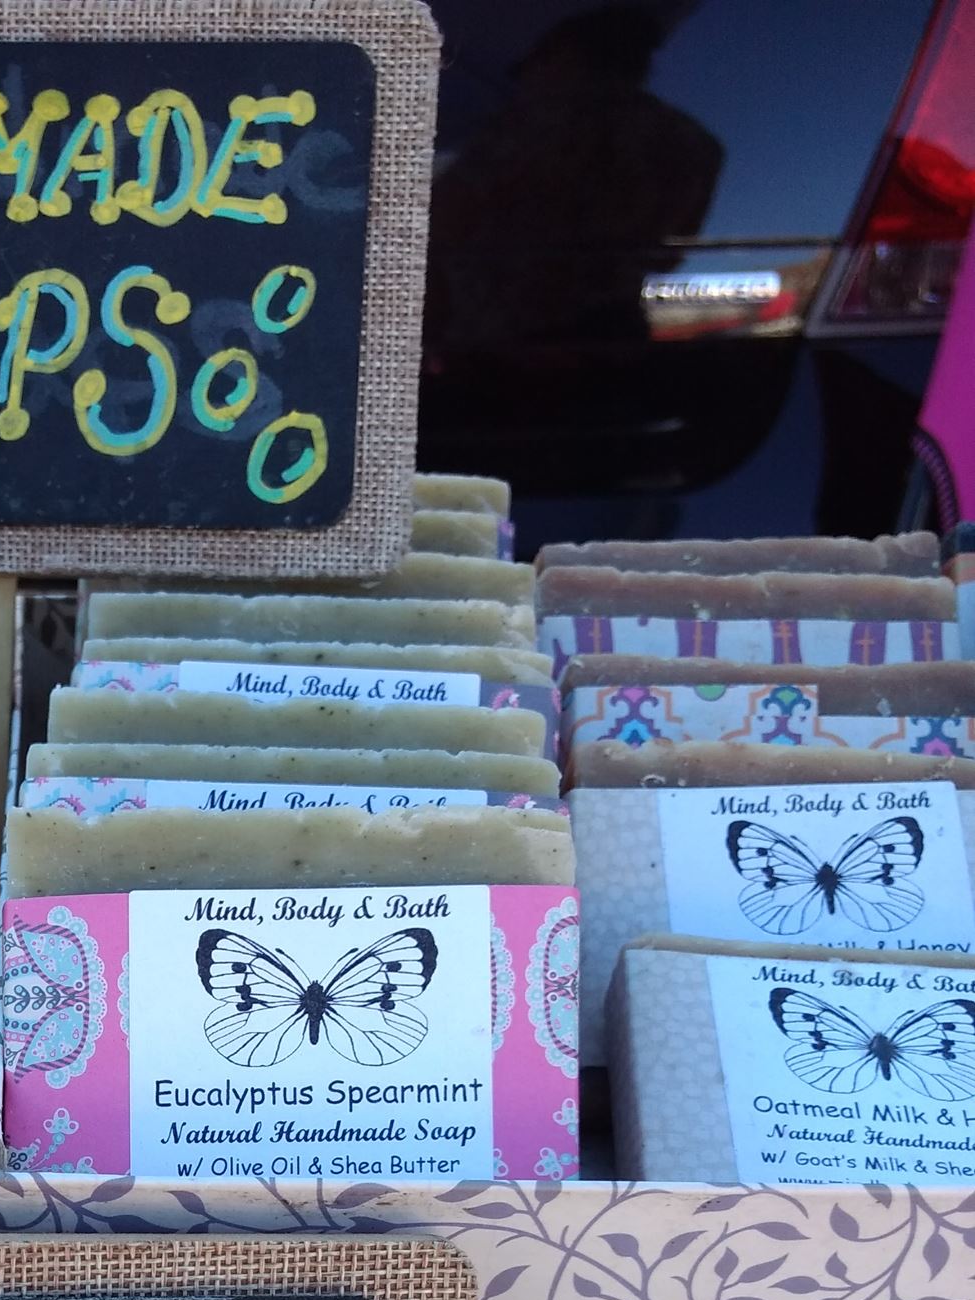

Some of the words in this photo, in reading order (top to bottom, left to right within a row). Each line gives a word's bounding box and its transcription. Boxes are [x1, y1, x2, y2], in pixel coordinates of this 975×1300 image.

[226, 672, 293, 698] Mind,
[300, 676, 360, 701] Body
[368, 679, 385, 699] &
[392, 680, 448, 702] Bath
[284, 792, 349, 809] Bd
[711, 796, 777, 817] Mind,
[784, 793, 845, 817] Body
[852, 793, 869, 810] &
[876, 791, 931, 810] Bath
[184, 897, 264, 926] Mind,
[272, 896, 345, 928] Body
[353, 895, 374, 920] &
[383, 894, 451, 919] Bath
[752, 966, 825, 988] Mind,
[832, 969, 898, 994] Body
[906, 974, 925, 989] &
[154, 1079, 313, 1114] Eucalyptus
[326, 1078, 483, 1112] Spearmint
[753, 1095, 861, 1119] Oatmeal
[873, 1103, 928, 1125] Milk
[937, 1108, 955, 1127] &
[160, 1121, 262, 1145] Natural
[270, 1119, 406, 1143] Handmade
[414, 1118, 476, 1146] Soap
[767, 1124, 857, 1144] Natural
[177, 1157, 203, 1177] w/
[211, 1157, 264, 1176] Olive
[271, 1156, 301, 1175] Oil
[308, 1157, 323, 1175] &
[330, 1155, 382, 1175] Shea
[390, 1156, 460, 1174] Butter
[761, 1150, 787, 1164] w/
[795, 1152, 857, 1169] Goat's
[865, 1156, 908, 1172] Milk
[914, 1160, 928, 1174] &
[935, 1161, 975, 1176] She
